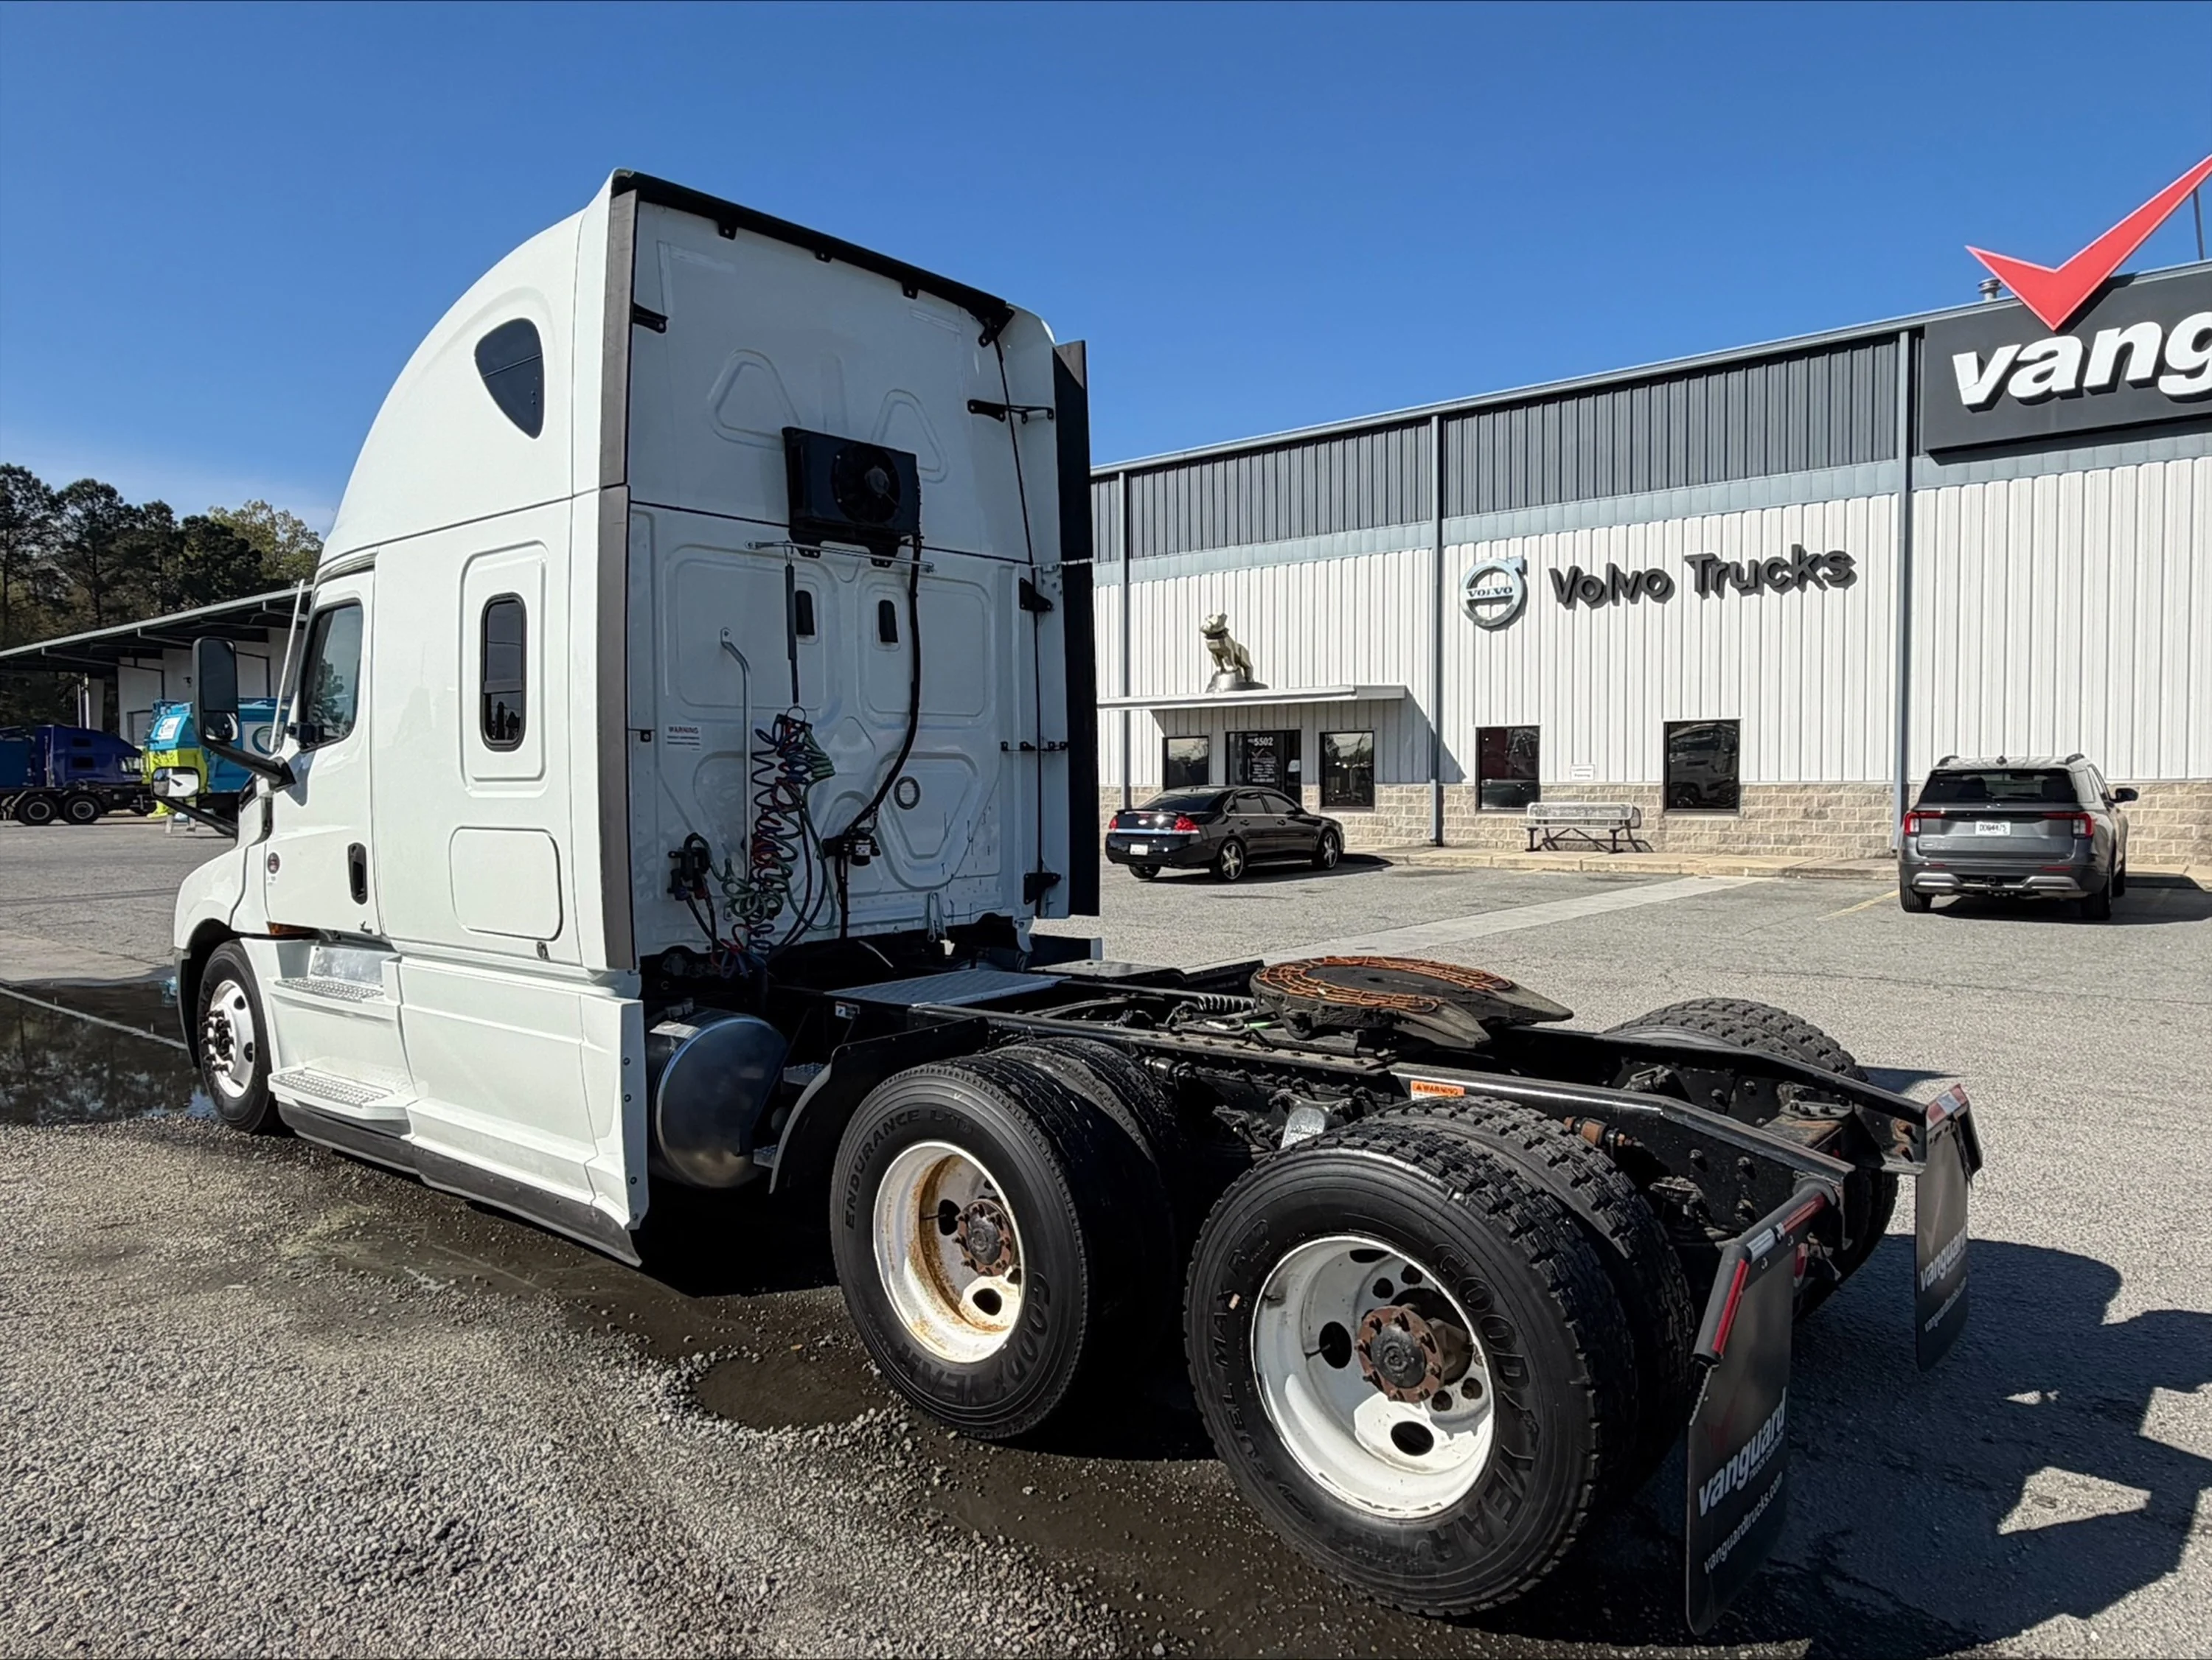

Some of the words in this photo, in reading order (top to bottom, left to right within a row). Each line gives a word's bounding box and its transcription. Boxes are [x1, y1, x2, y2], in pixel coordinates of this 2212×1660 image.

[1952, 311, 2212, 406] vang
[1467, 587, 1513, 598] VOLVO
[1549, 562, 1673, 607] Volvo
[1684, 544, 1856, 597] Trucks
[1253, 737, 1274, 747] 5502
[1422, 1084, 1458, 1096] WARNING
[845, 1109, 920, 1230] ENDURANCE
[1427, 1244, 1540, 1560] GOODYEAR
[1698, 1387, 1787, 1517] vanguard
[1703, 1471, 1783, 1574] vanguardtrucks.com
